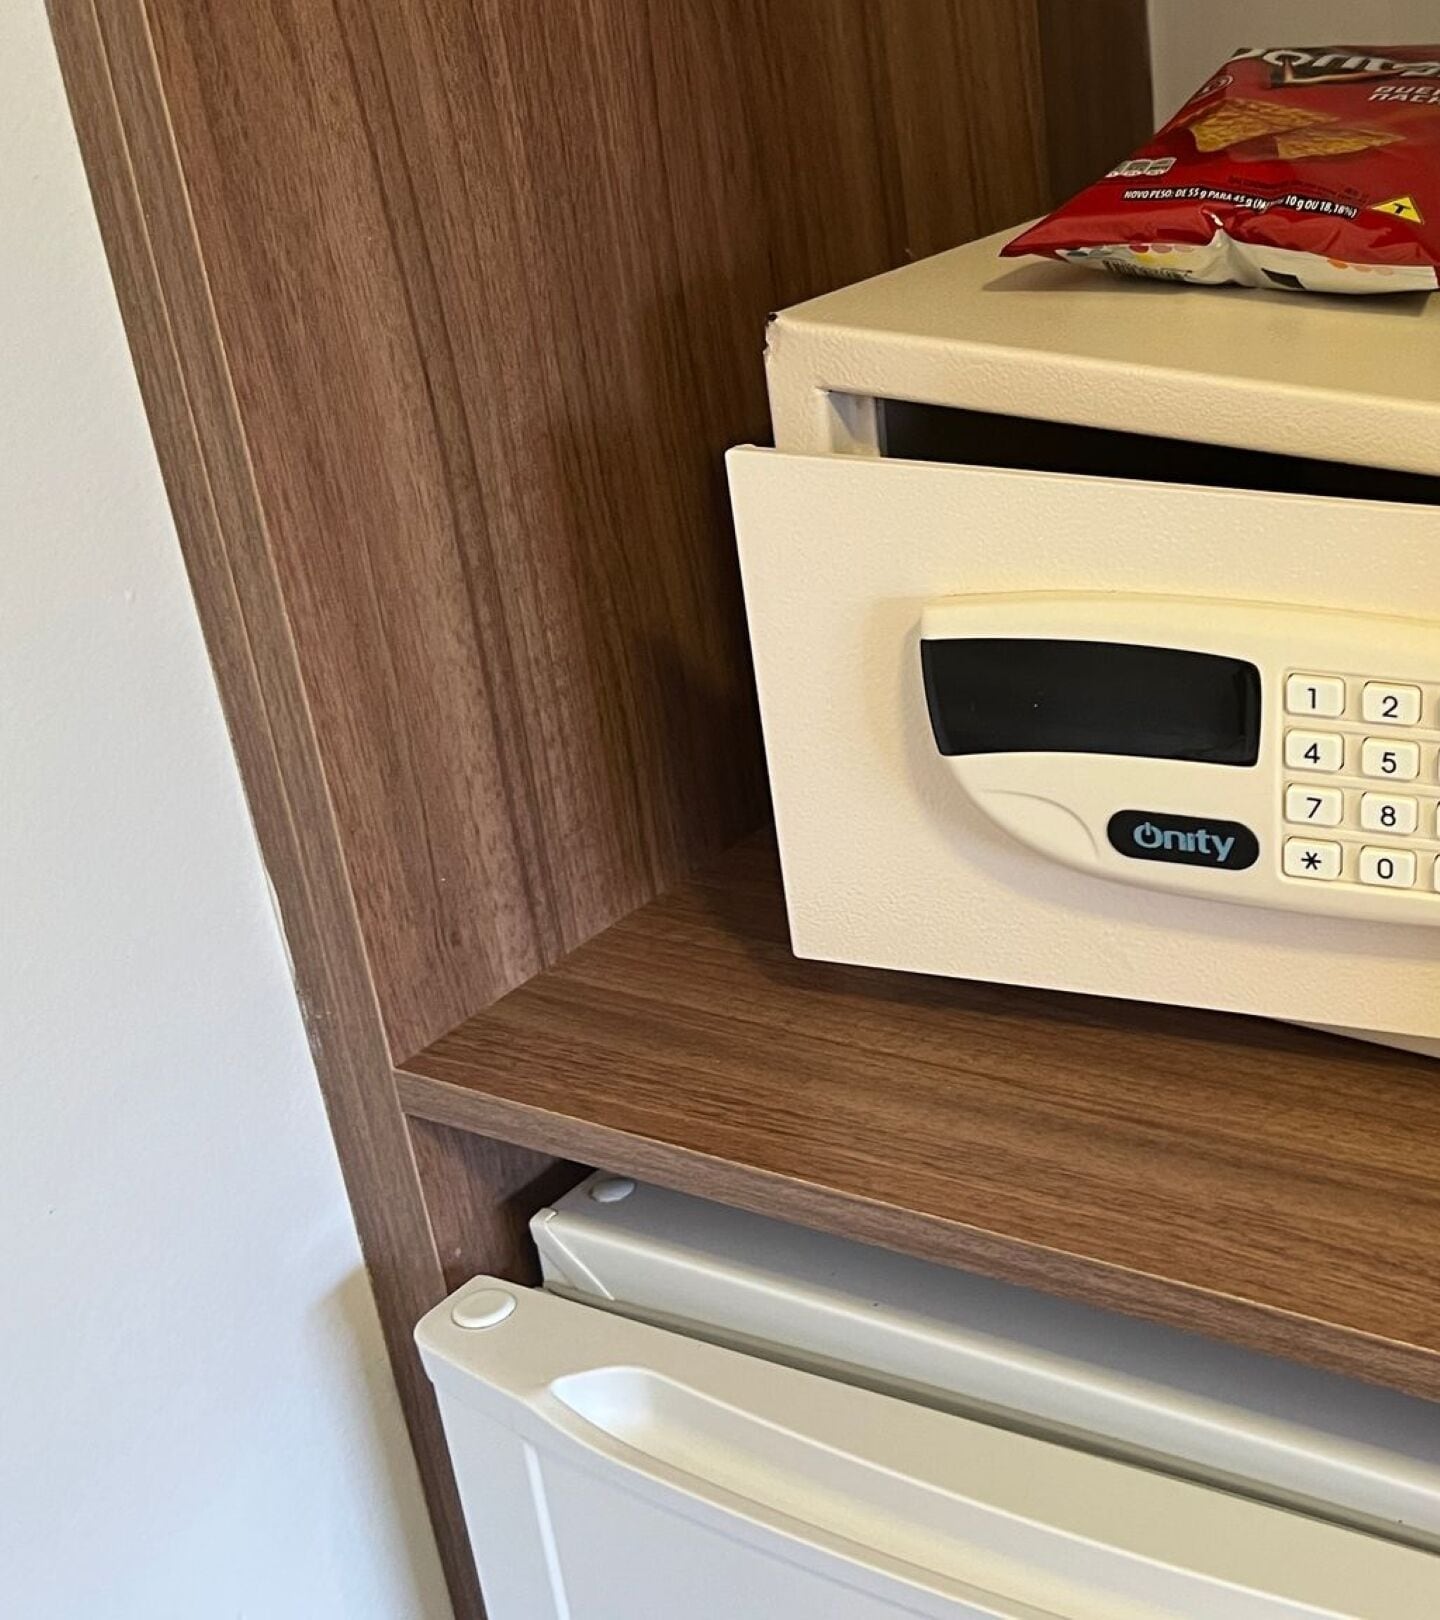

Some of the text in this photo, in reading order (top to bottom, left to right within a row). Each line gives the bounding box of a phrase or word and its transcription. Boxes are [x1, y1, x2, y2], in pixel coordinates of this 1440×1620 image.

[1124, 190, 1149, 199] NOVO
[1174, 188, 1187, 198] DE
[1199, 190, 1207, 199] g
[1207, 190, 1232, 201] PARA
[1284, 194, 1298, 206] 10
[1296, 199, 1305, 211] g
[1304, 200, 1320, 210] OU
[1393, 203, 1412, 215] T
[1307, 687, 1317, 709] 1
[1382, 695, 1399, 718] 2
[1303, 742, 1321, 764] 4
[1381, 751, 1397, 774] 5
[1306, 797, 1323, 819] 7
[1380, 805, 1397, 827] 8
[1132, 820, 1236, 863] Onity
